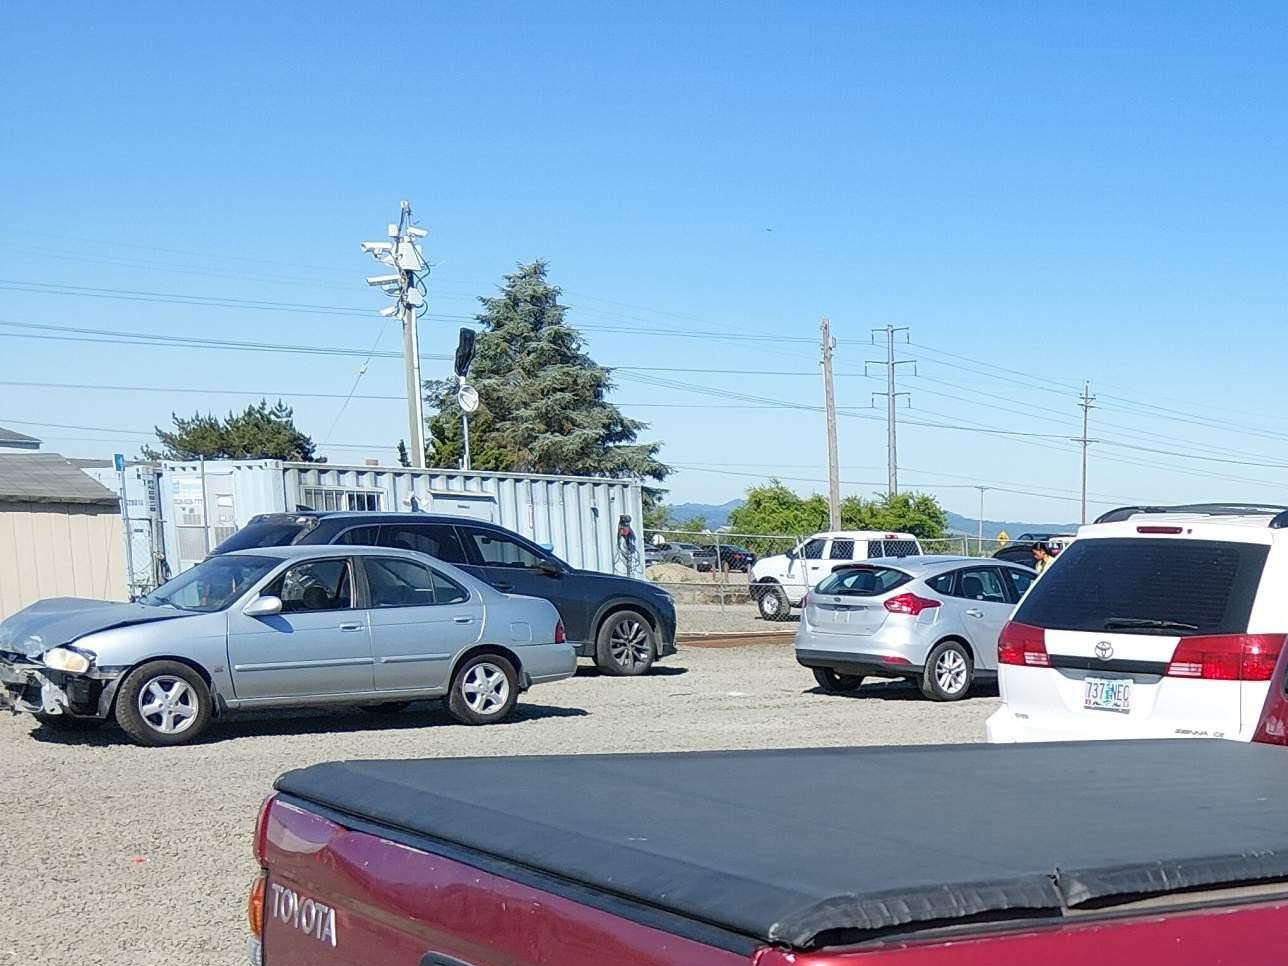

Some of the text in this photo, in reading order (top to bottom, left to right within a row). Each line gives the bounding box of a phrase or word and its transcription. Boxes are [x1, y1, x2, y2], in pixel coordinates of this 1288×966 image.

[1086, 681, 1130, 702] 737 NEC
[271, 883, 337, 947] TOYOTA
